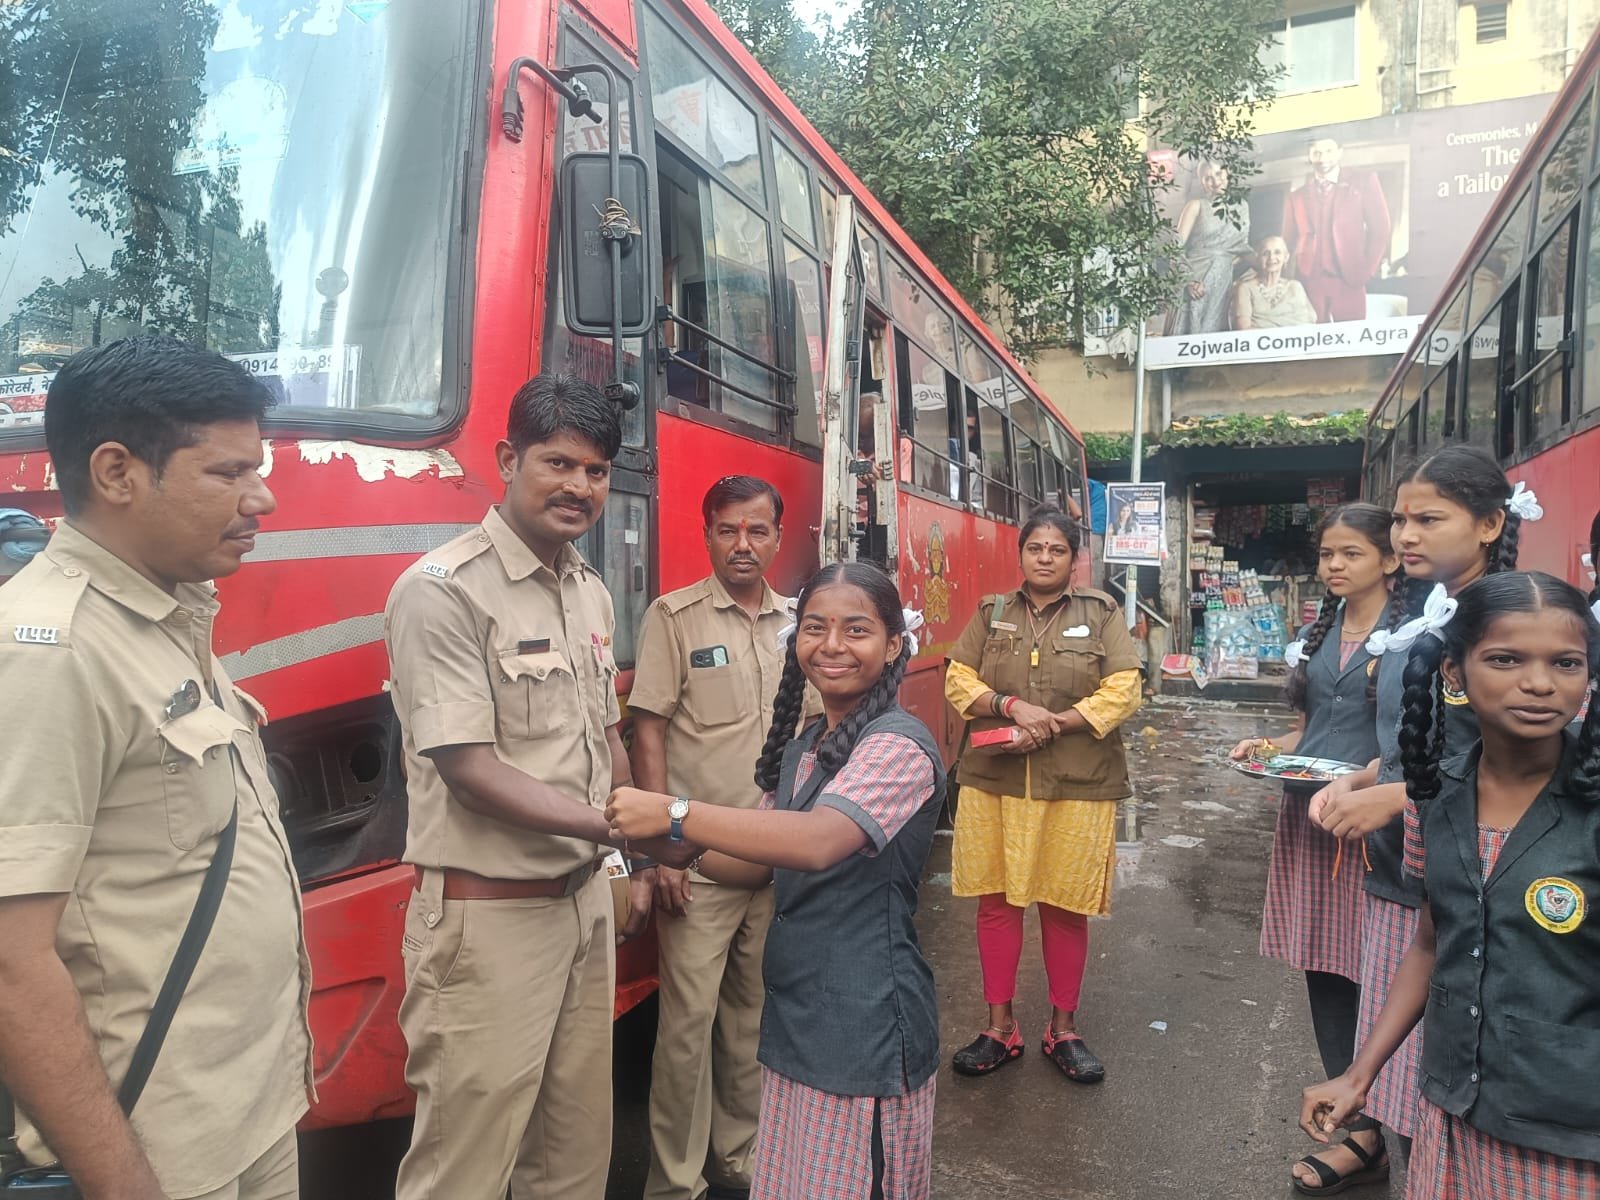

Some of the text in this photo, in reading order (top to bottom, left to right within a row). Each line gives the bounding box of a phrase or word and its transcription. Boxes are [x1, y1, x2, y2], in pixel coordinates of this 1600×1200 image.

[1446, 126, 1521, 146] Ceremonies,
[1481, 145, 1520, 167] The
[1438, 181, 1449, 198] a
[1177, 338, 1250, 359] Zojwala
[1359, 327, 1409, 346] Agra
